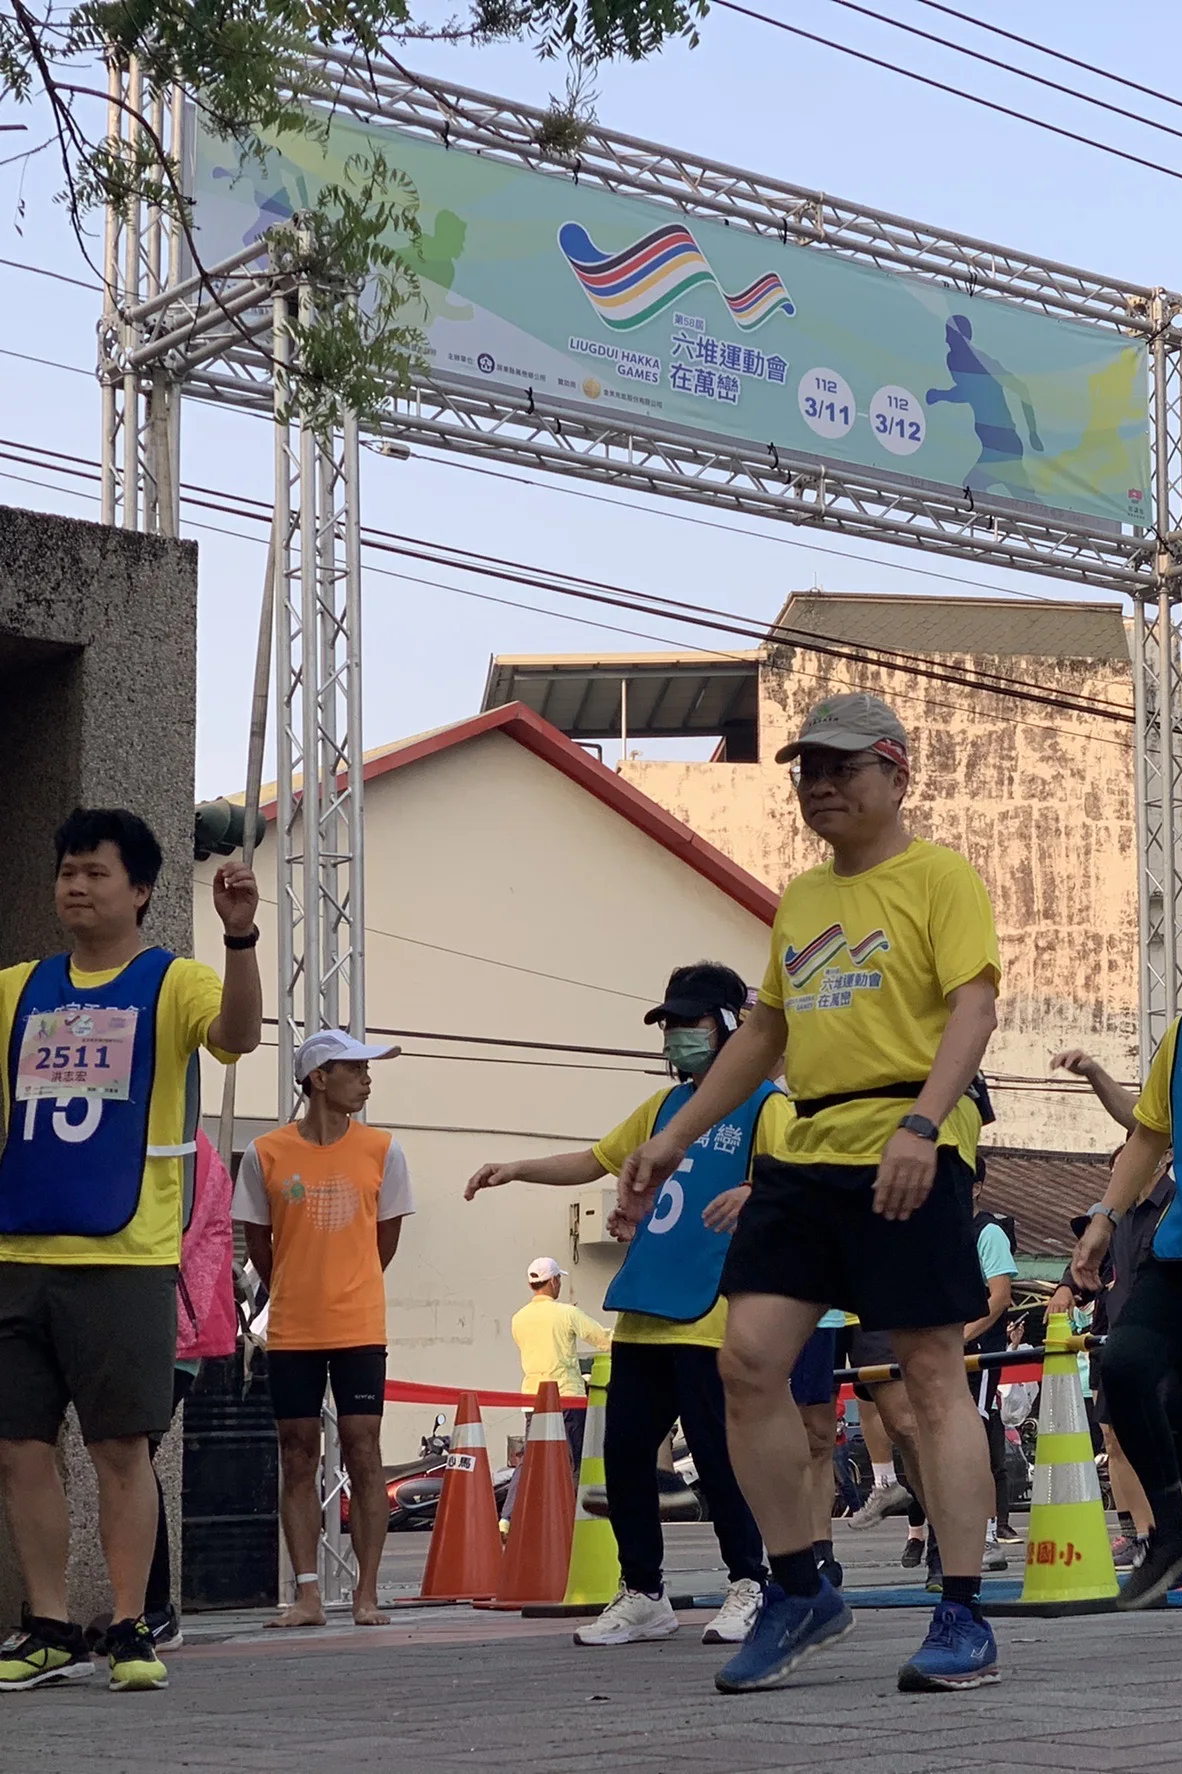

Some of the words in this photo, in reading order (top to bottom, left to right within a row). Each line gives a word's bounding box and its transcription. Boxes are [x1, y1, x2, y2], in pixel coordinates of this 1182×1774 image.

[570, 337, 617, 360] LIUGDUI
[621, 351, 660, 370] HAKKA
[672, 332, 788, 382] 六堆運動會
[617, 364, 659, 384] GAMES
[670, 363, 739, 403] 在萬巒
[815, 377, 837, 394] 112
[804, 396, 849, 426] 3/11
[887, 395, 909, 411] 112
[875, 413, 921, 442] 3/12
[36, 1046, 110, 1070] 2511
